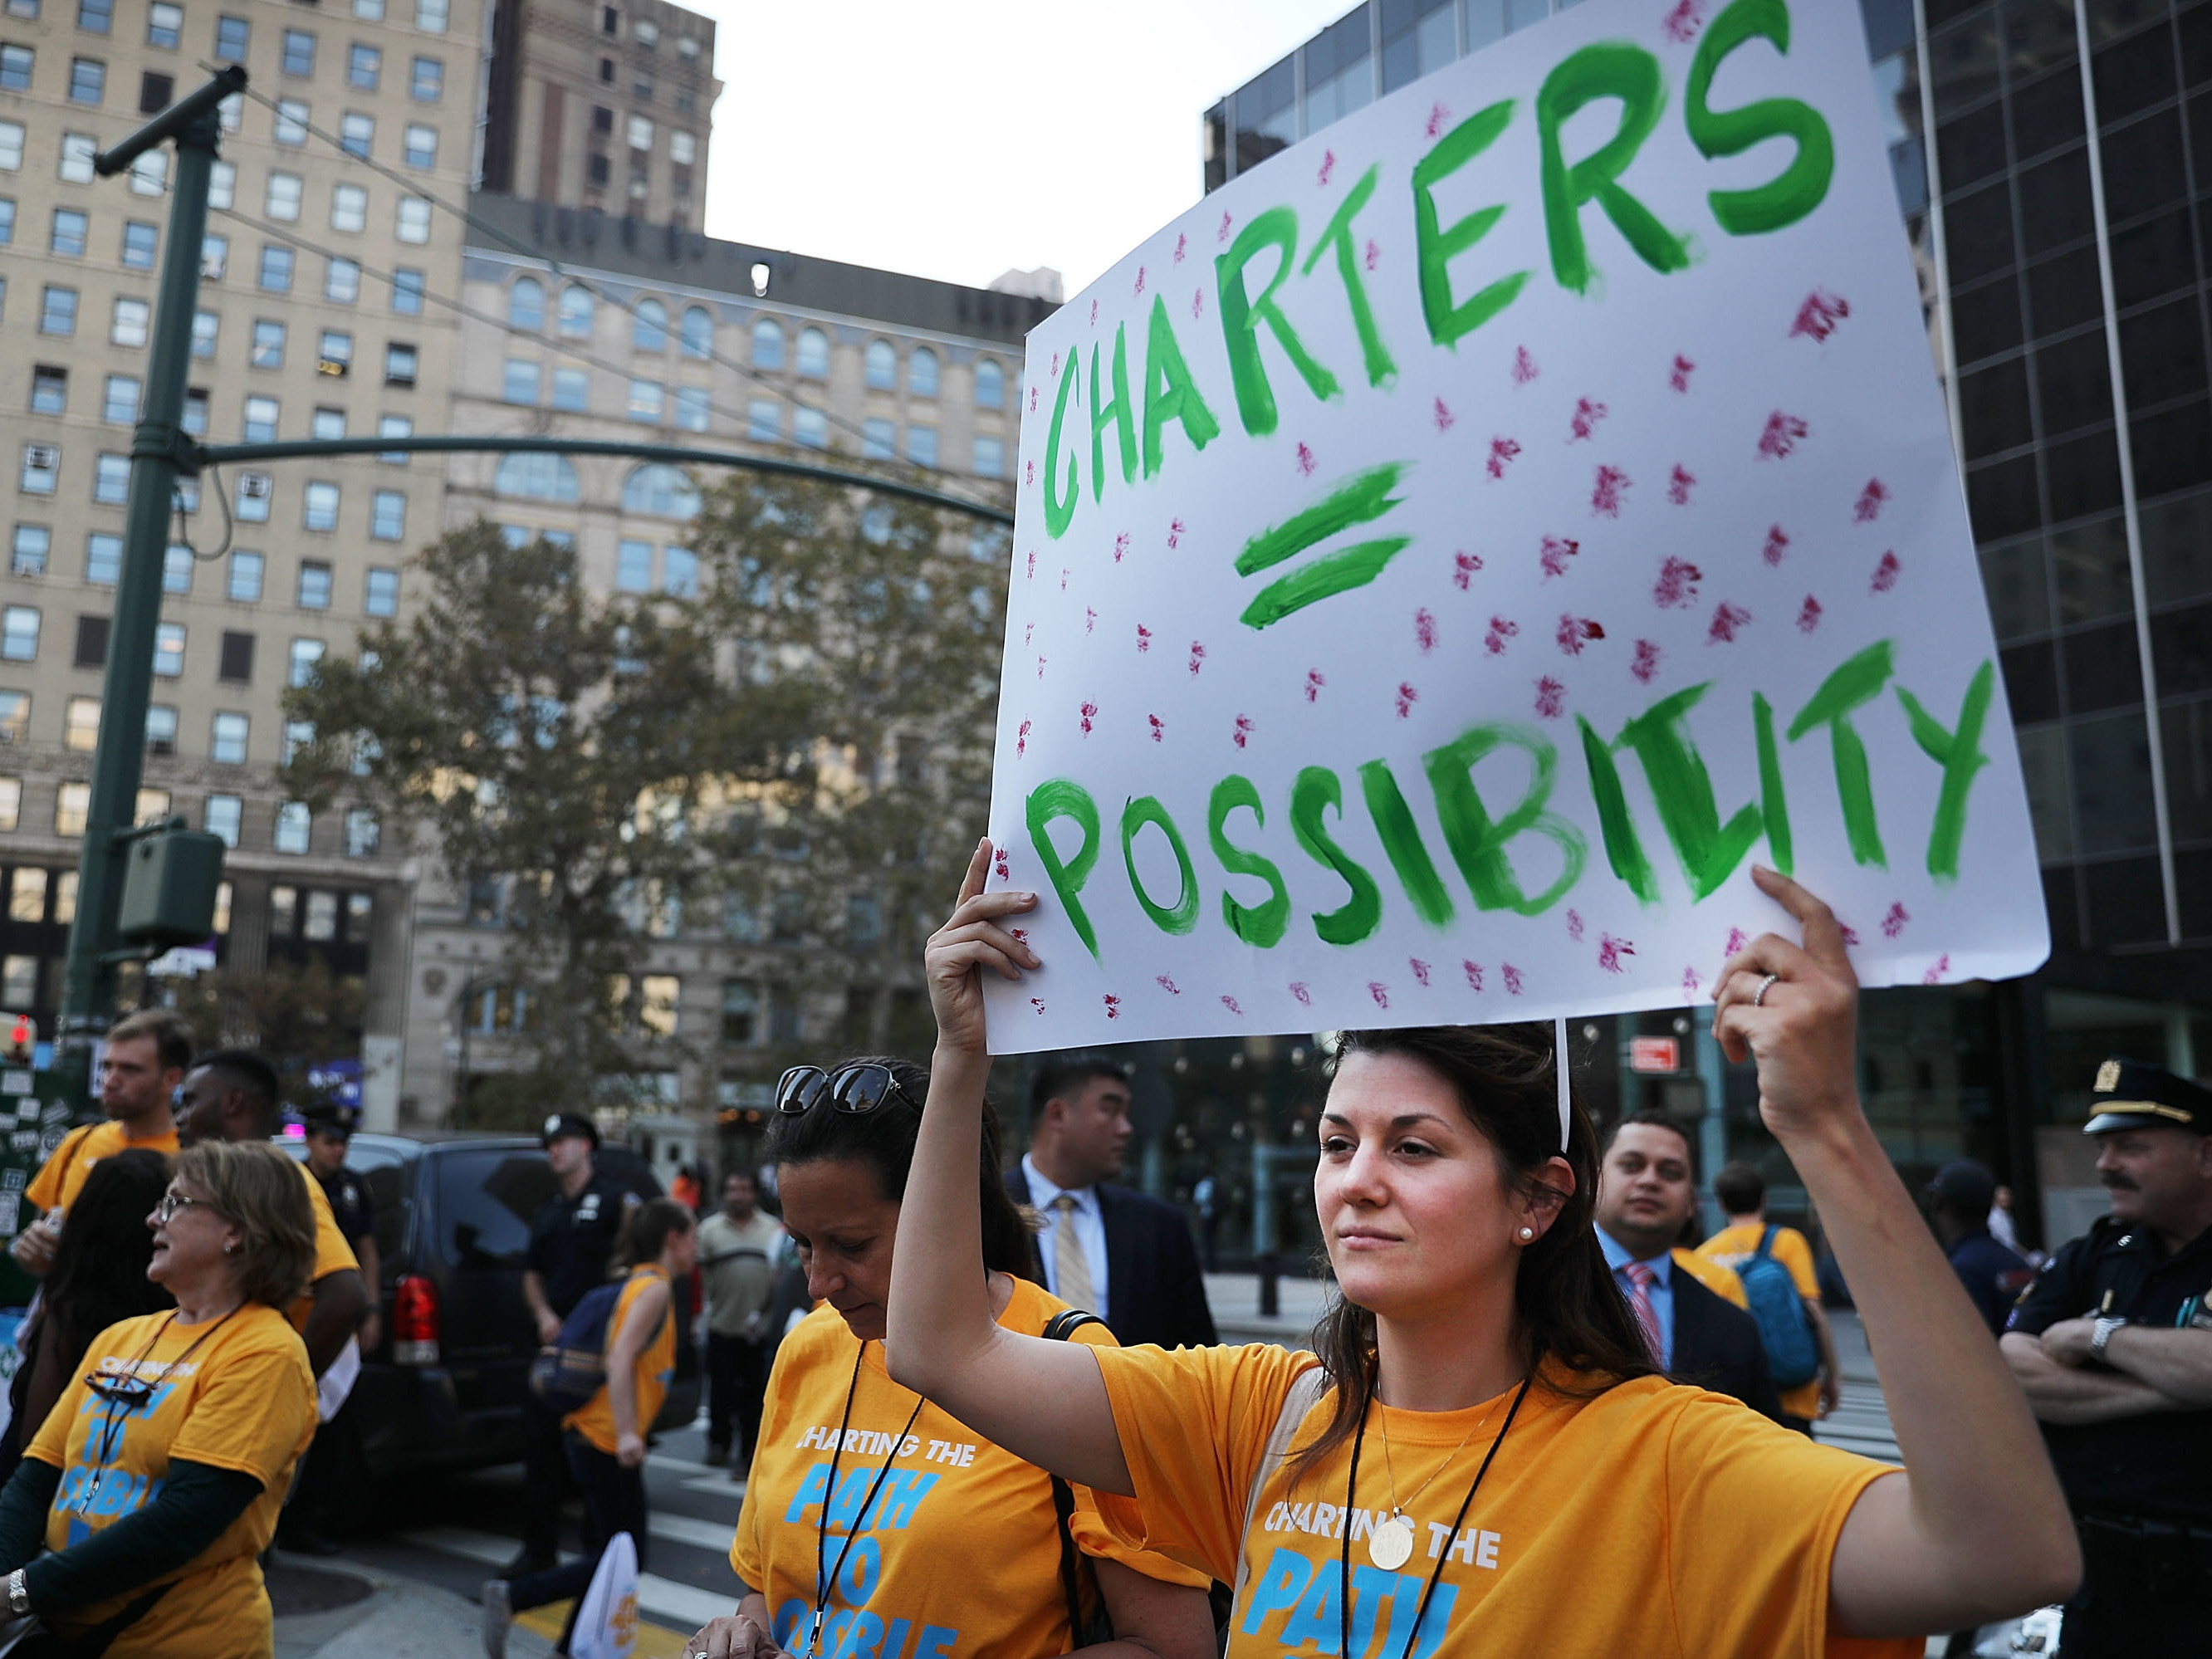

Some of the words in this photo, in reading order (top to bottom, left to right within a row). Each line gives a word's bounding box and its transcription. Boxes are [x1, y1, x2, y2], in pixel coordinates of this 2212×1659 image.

[1043, 0, 1835, 541] CHARTERS
[1025, 639, 1993, 962] POSSIBILITY
[925, 1439, 976, 1468] THE
[783, 1462, 942, 1532] PATH
[816, 1534, 881, 1608] TO
[1264, 1500, 1416, 1542] CHARTIN
[1427, 1521, 1500, 1569] THE
[1240, 1546, 1460, 1659] PATH
